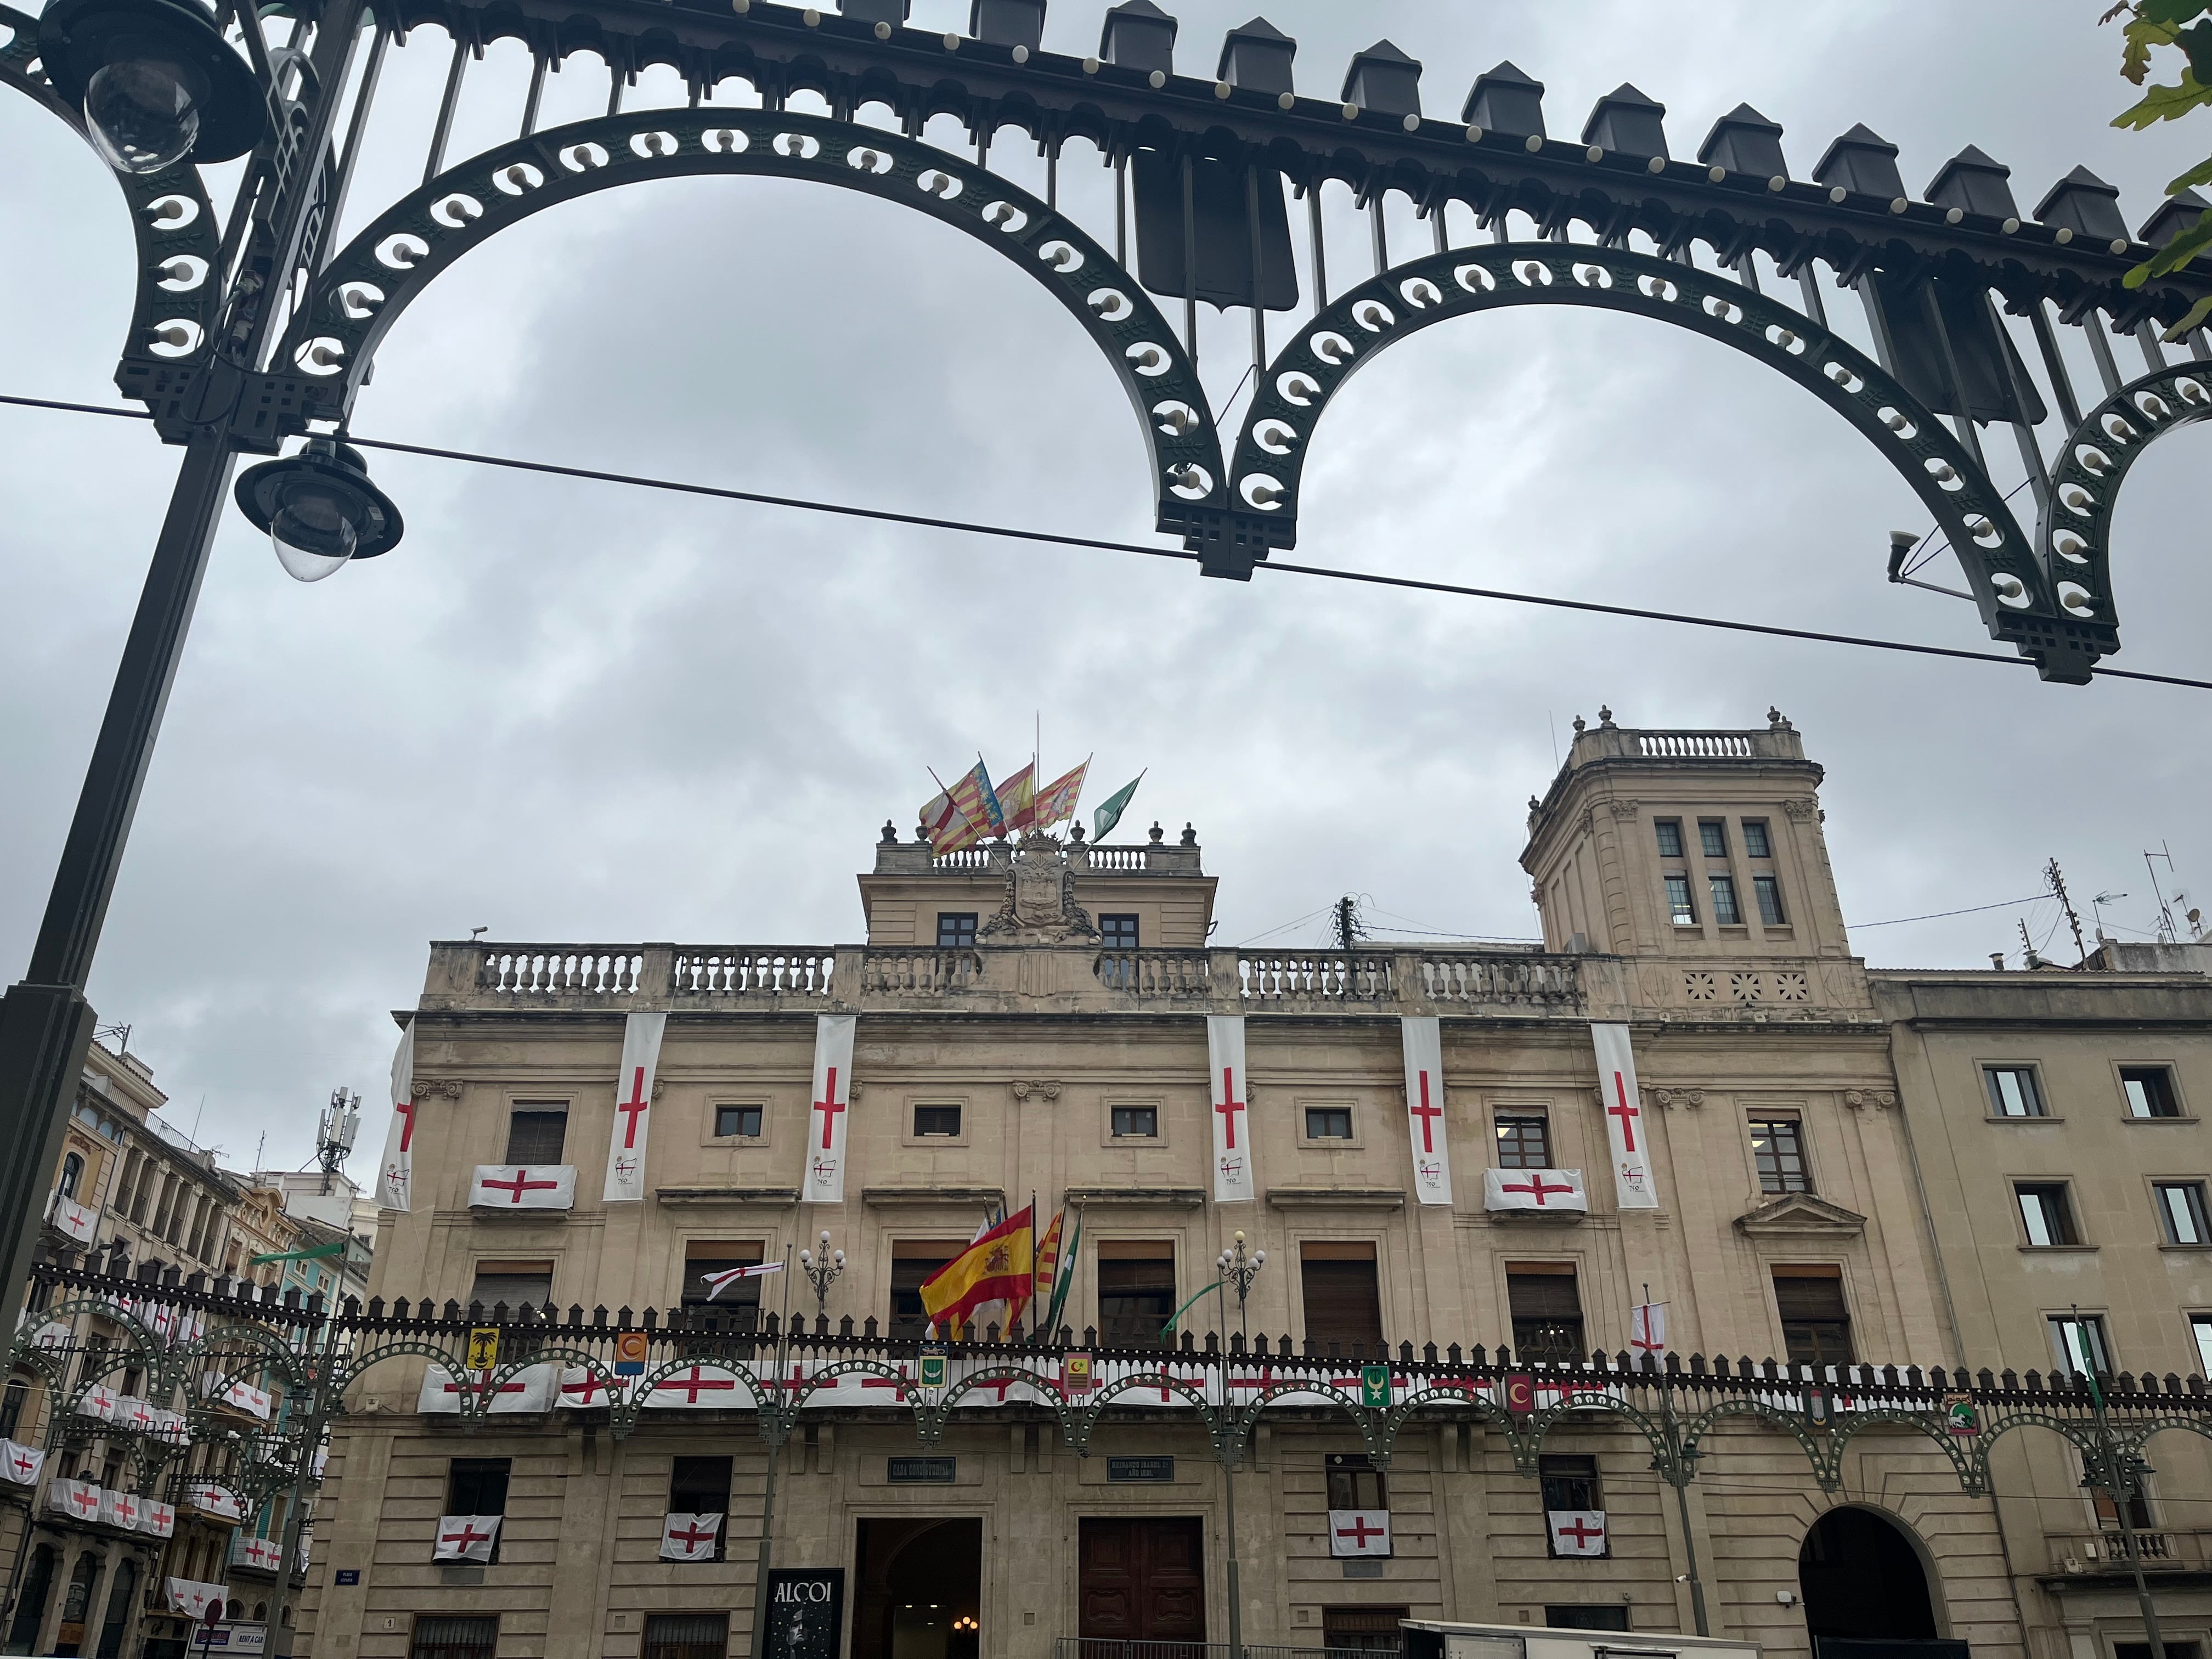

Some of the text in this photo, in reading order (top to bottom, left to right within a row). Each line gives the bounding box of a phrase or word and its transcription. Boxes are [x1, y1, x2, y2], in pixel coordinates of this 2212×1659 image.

[893, 1464, 949, 1476] CASA CONSISTORIAL
[774, 1582, 832, 1602] ALCOI
[238, 1635, 250, 1643] RENT
[255, 1635, 264, 1644] CAR
